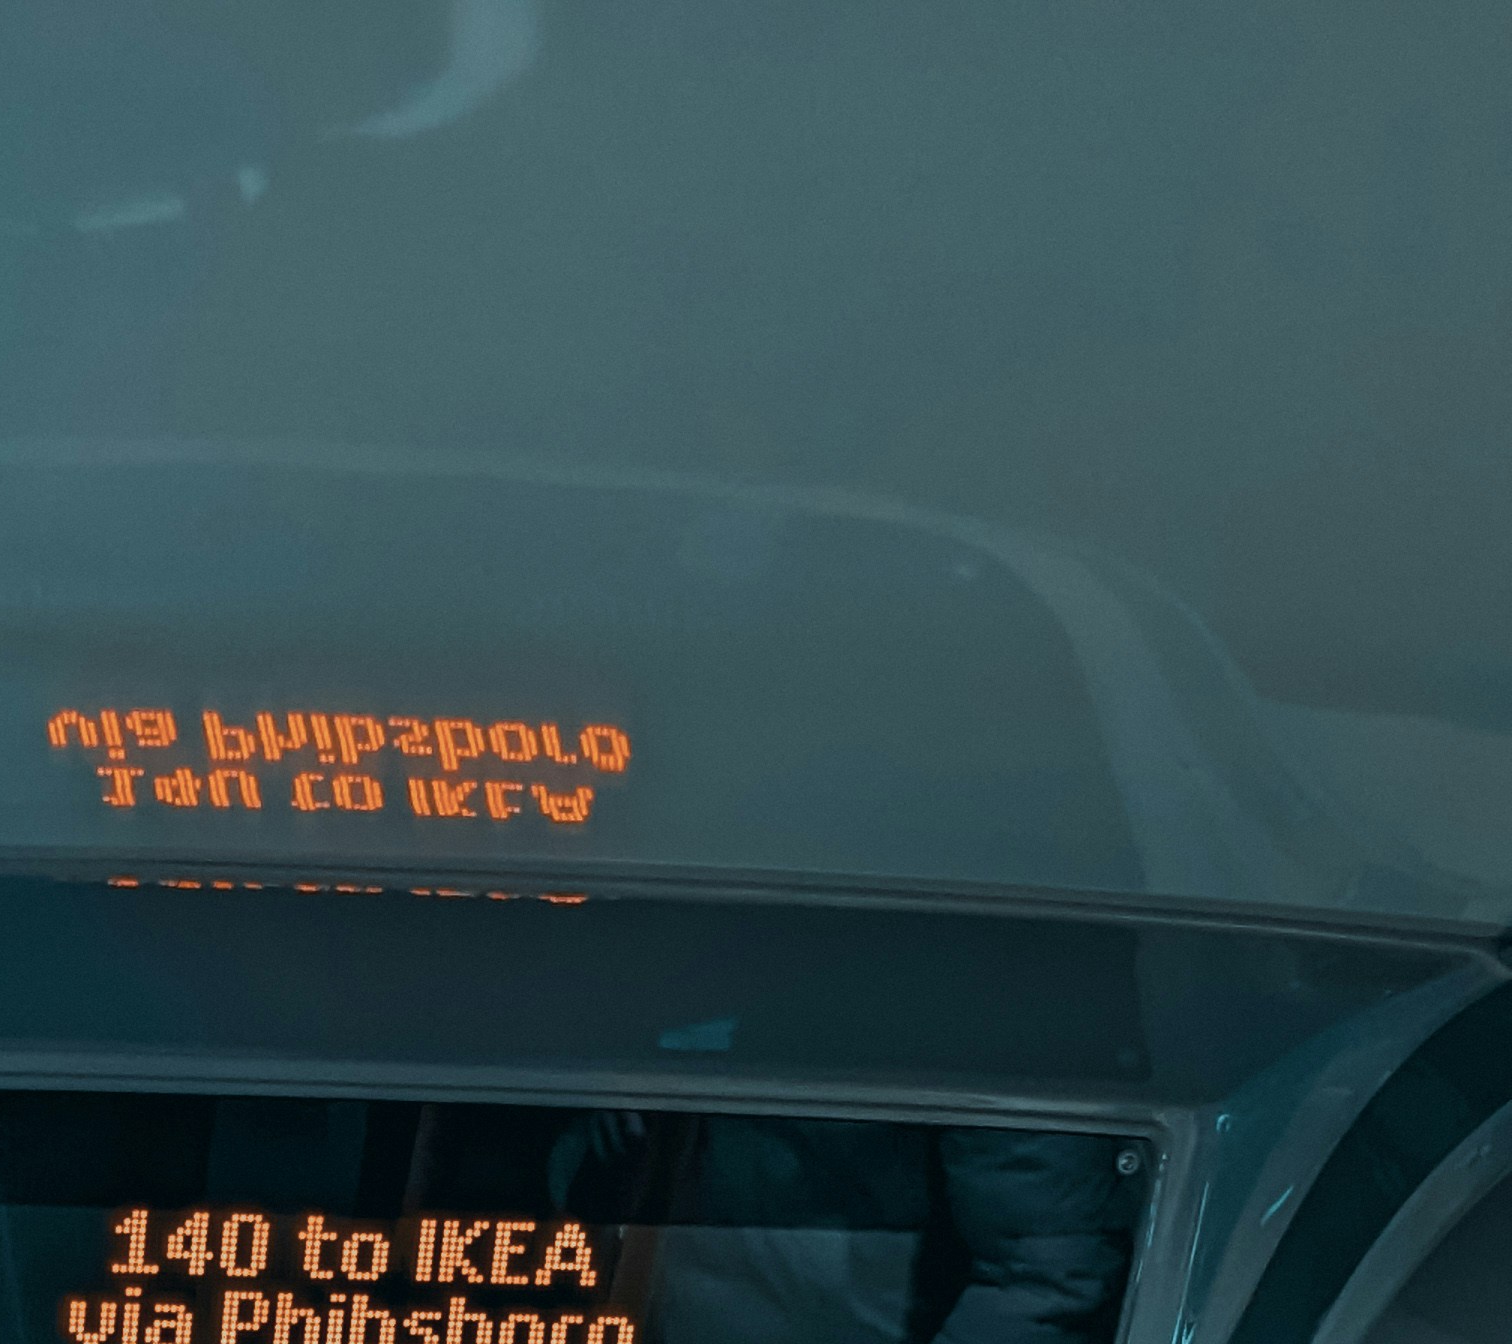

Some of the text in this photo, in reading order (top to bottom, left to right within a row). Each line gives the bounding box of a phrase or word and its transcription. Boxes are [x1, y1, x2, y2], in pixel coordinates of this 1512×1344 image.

[111, 1209, 598, 1288] 140 to IKEA
